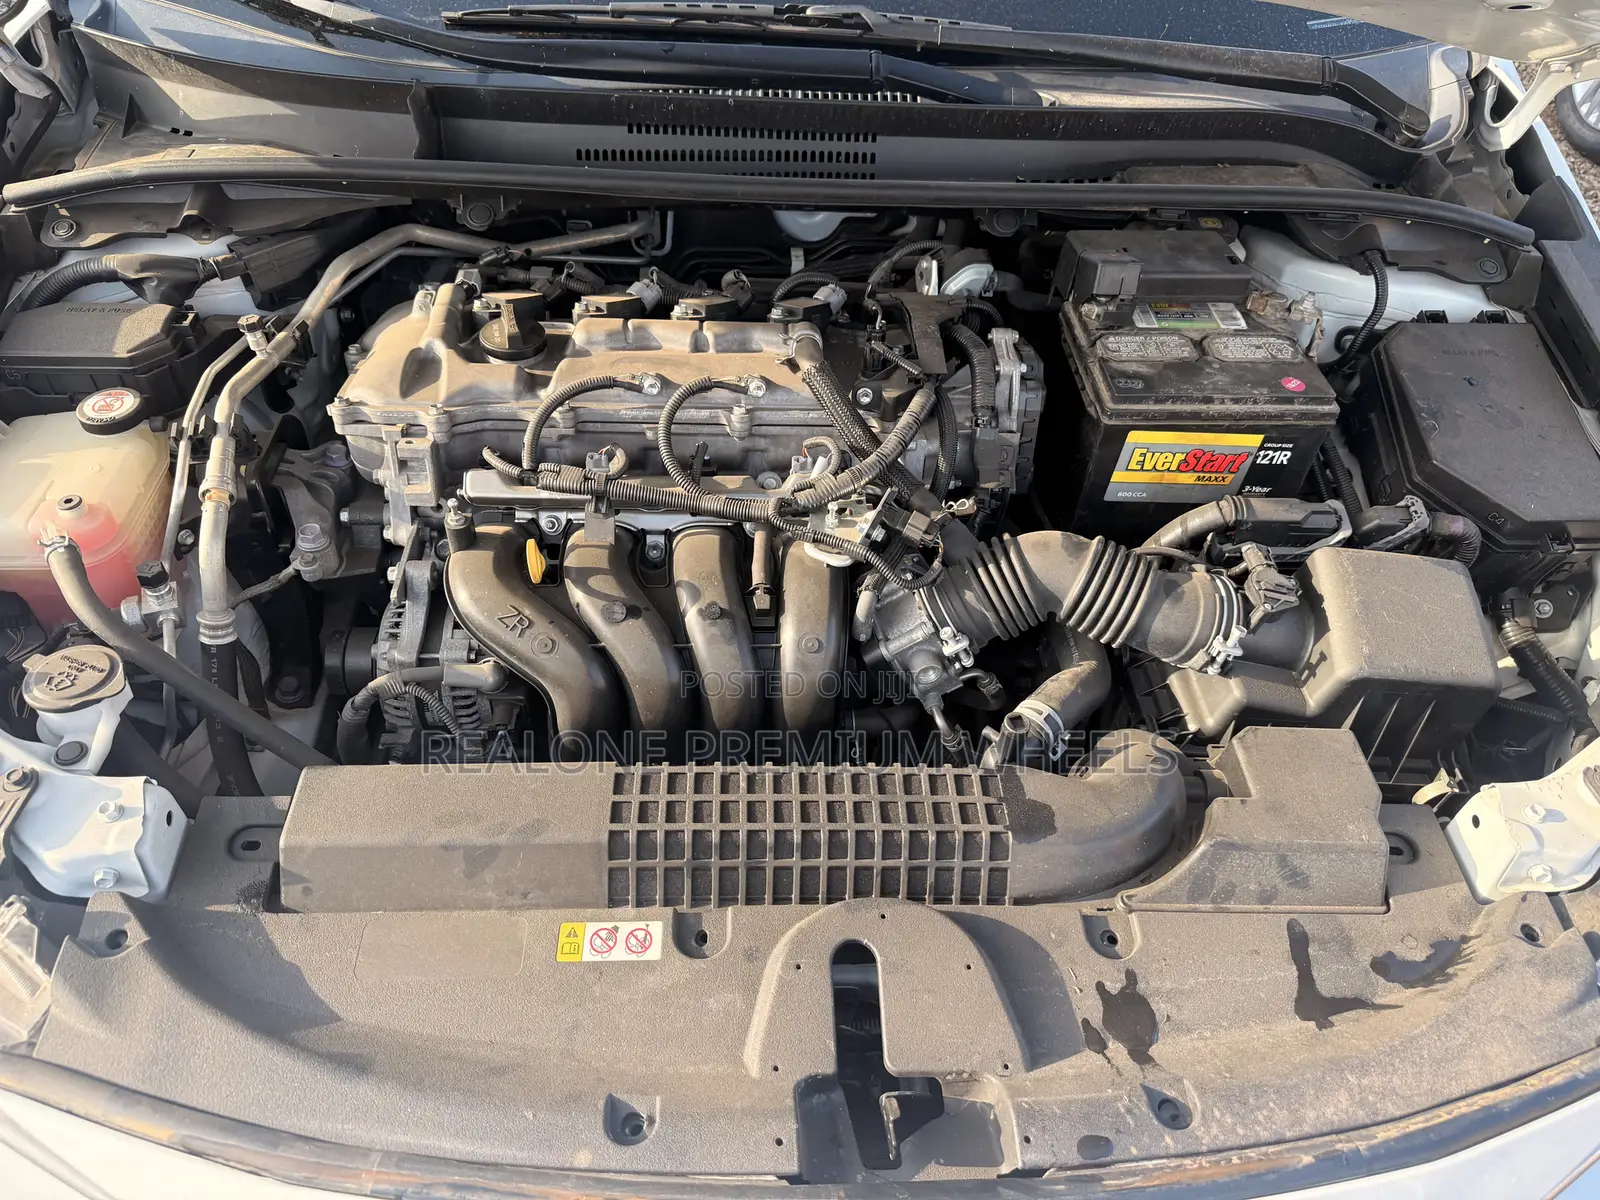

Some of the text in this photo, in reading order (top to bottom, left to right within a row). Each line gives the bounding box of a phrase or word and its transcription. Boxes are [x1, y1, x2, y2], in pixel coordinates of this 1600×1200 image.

[1126, 447, 1249, 473] EverStart
[1256, 450, 1292, 465] 121R
[1194, 474, 1229, 483] MAXX
[1241, 485, 1273, 493] 3-Year
[1487, 512, 1505, 525] C4
[495, 604, 531, 638] ZR
